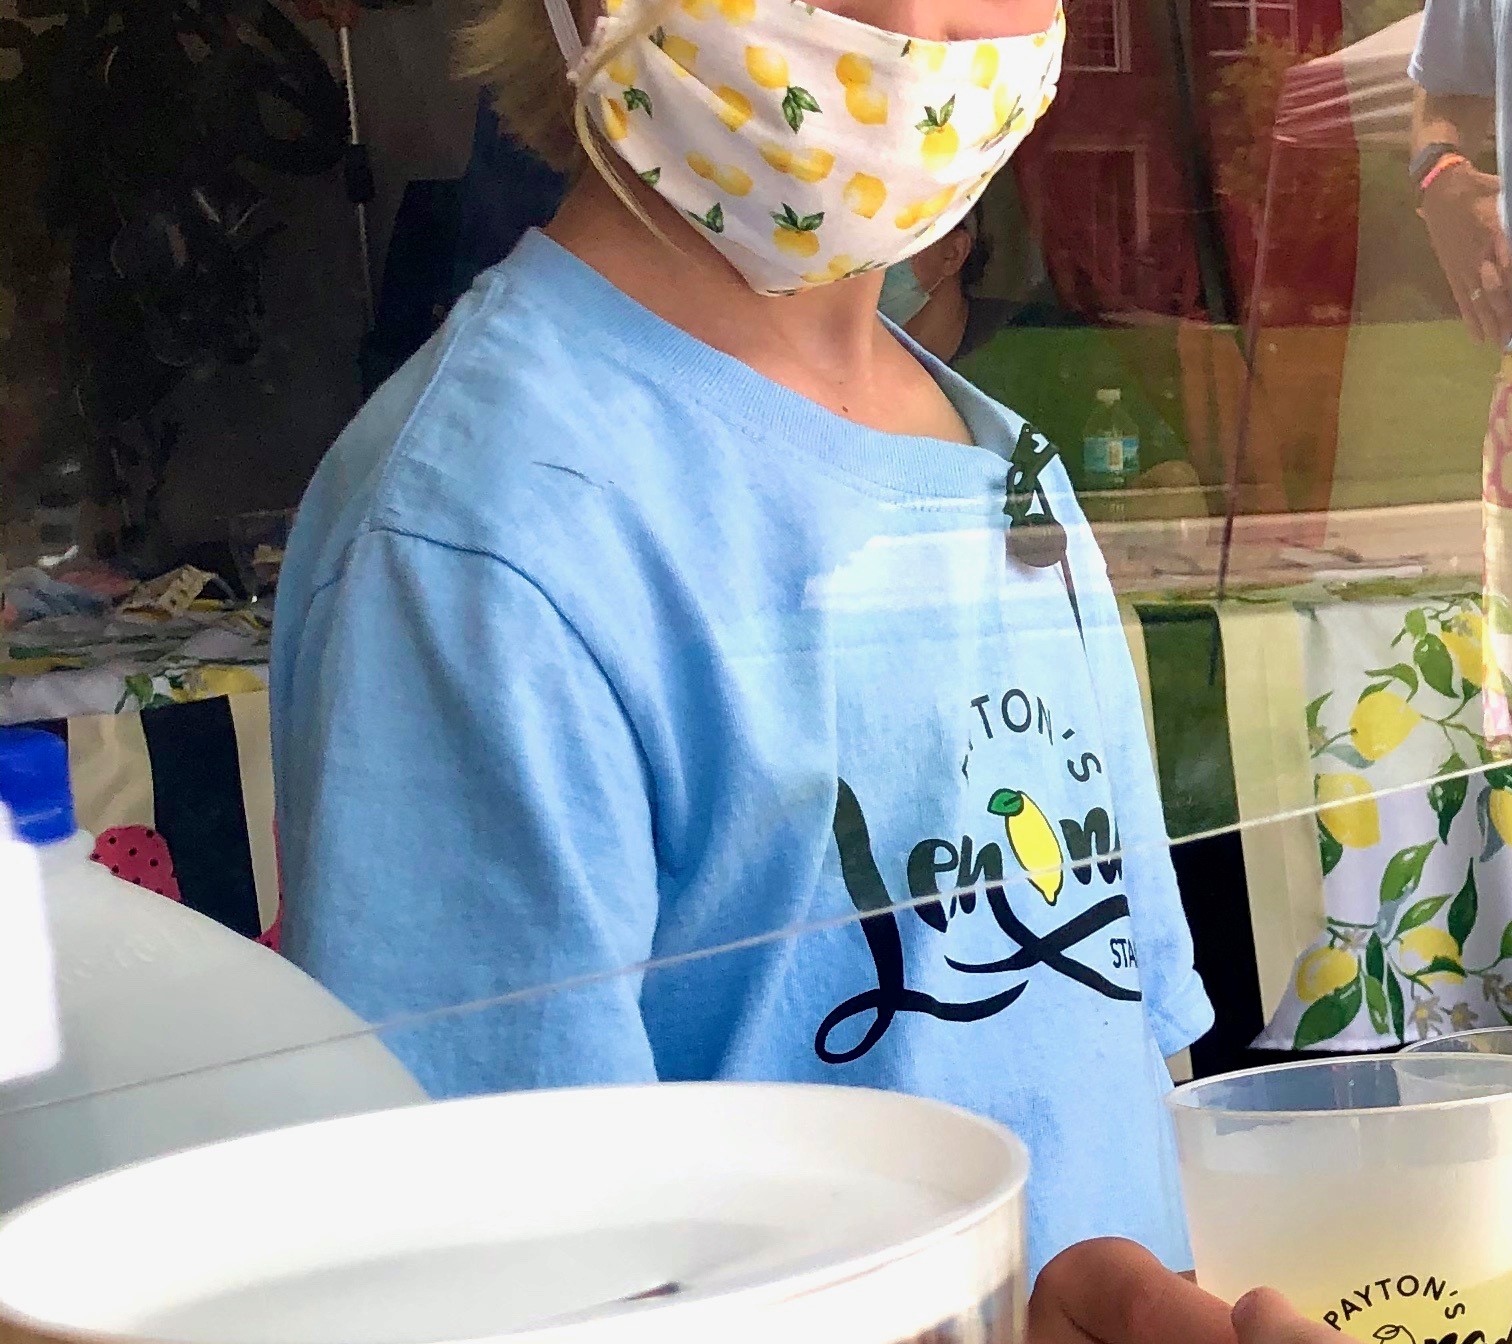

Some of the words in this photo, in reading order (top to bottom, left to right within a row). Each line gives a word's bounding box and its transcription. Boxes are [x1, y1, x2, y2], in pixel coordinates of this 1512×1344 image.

[962, 687, 1102, 783] TON'S
[1109, 937, 1140, 970] STA
[1323, 1274, 1465, 1331] PAYTON'S
